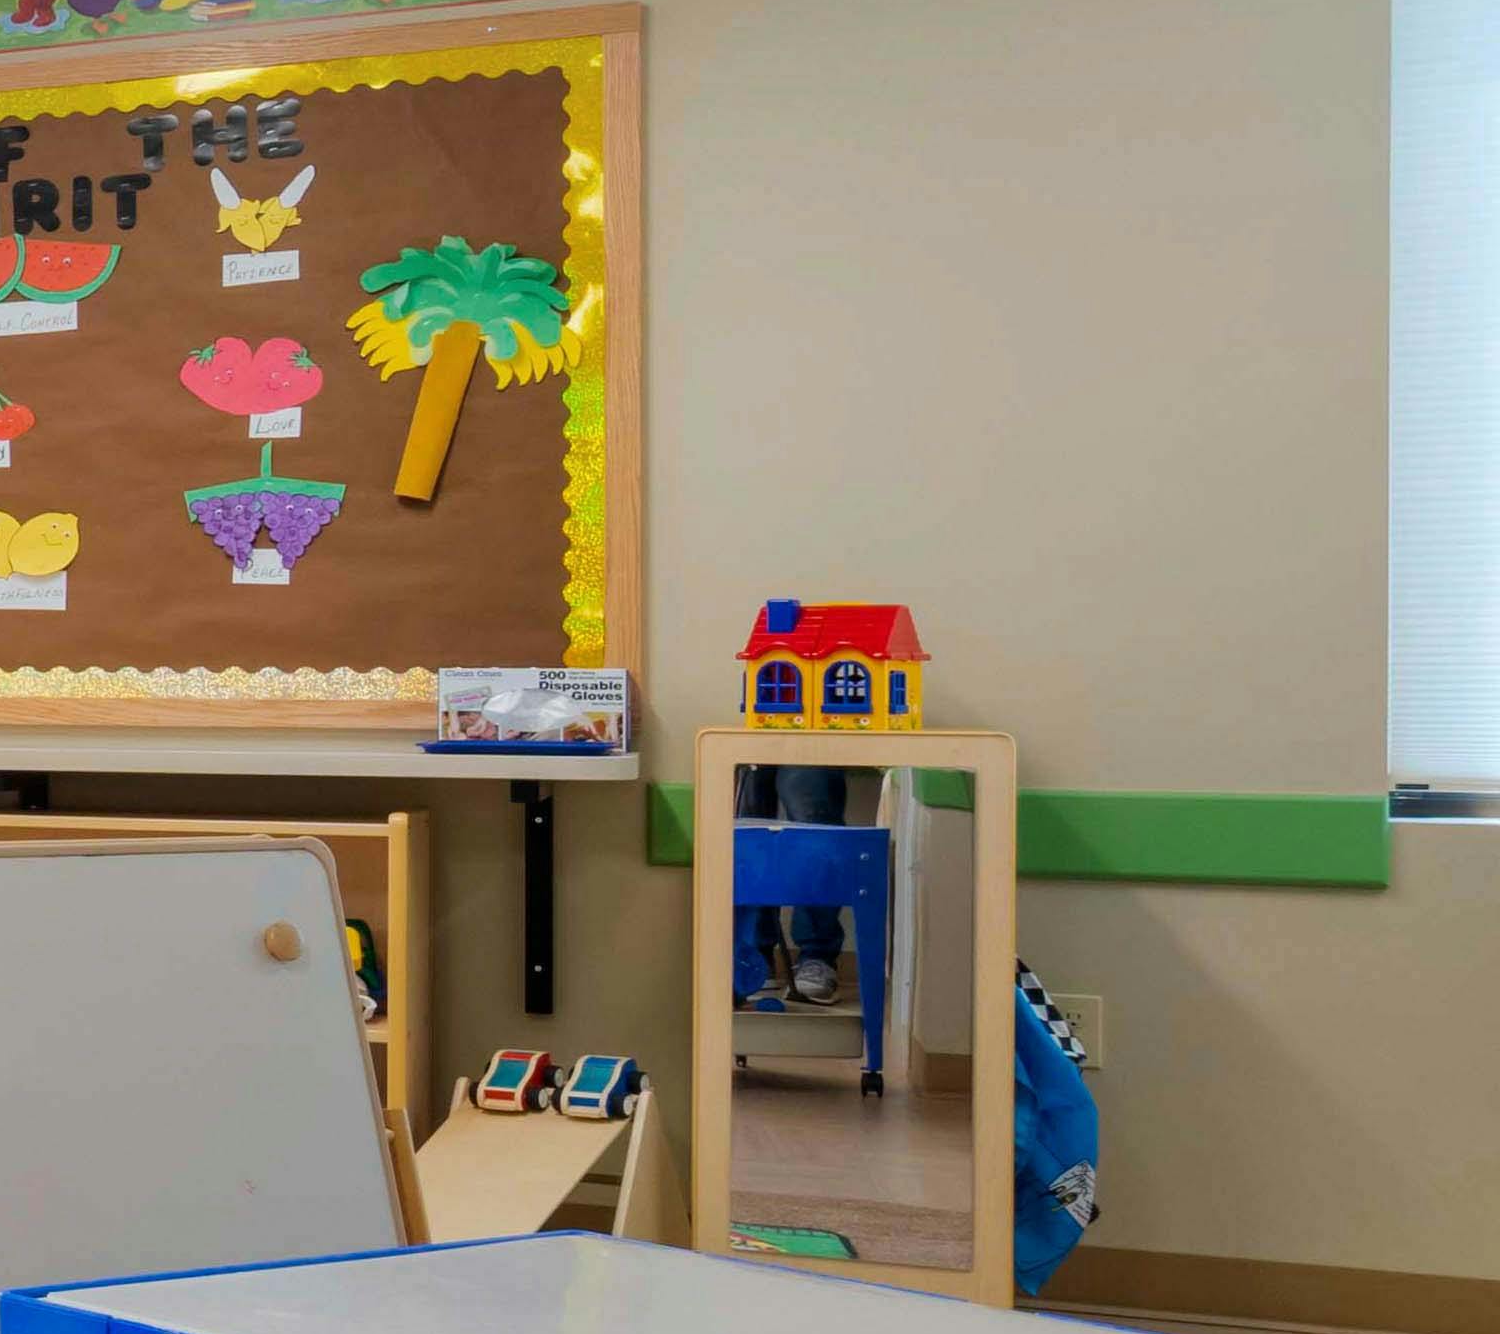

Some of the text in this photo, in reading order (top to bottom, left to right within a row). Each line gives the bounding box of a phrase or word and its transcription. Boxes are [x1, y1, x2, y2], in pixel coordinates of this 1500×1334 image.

[127, 98, 304, 172] THE
[539, 670, 567, 680] 500
[539, 680, 623, 692] Disposable
[571, 691, 624, 702] Gloves
